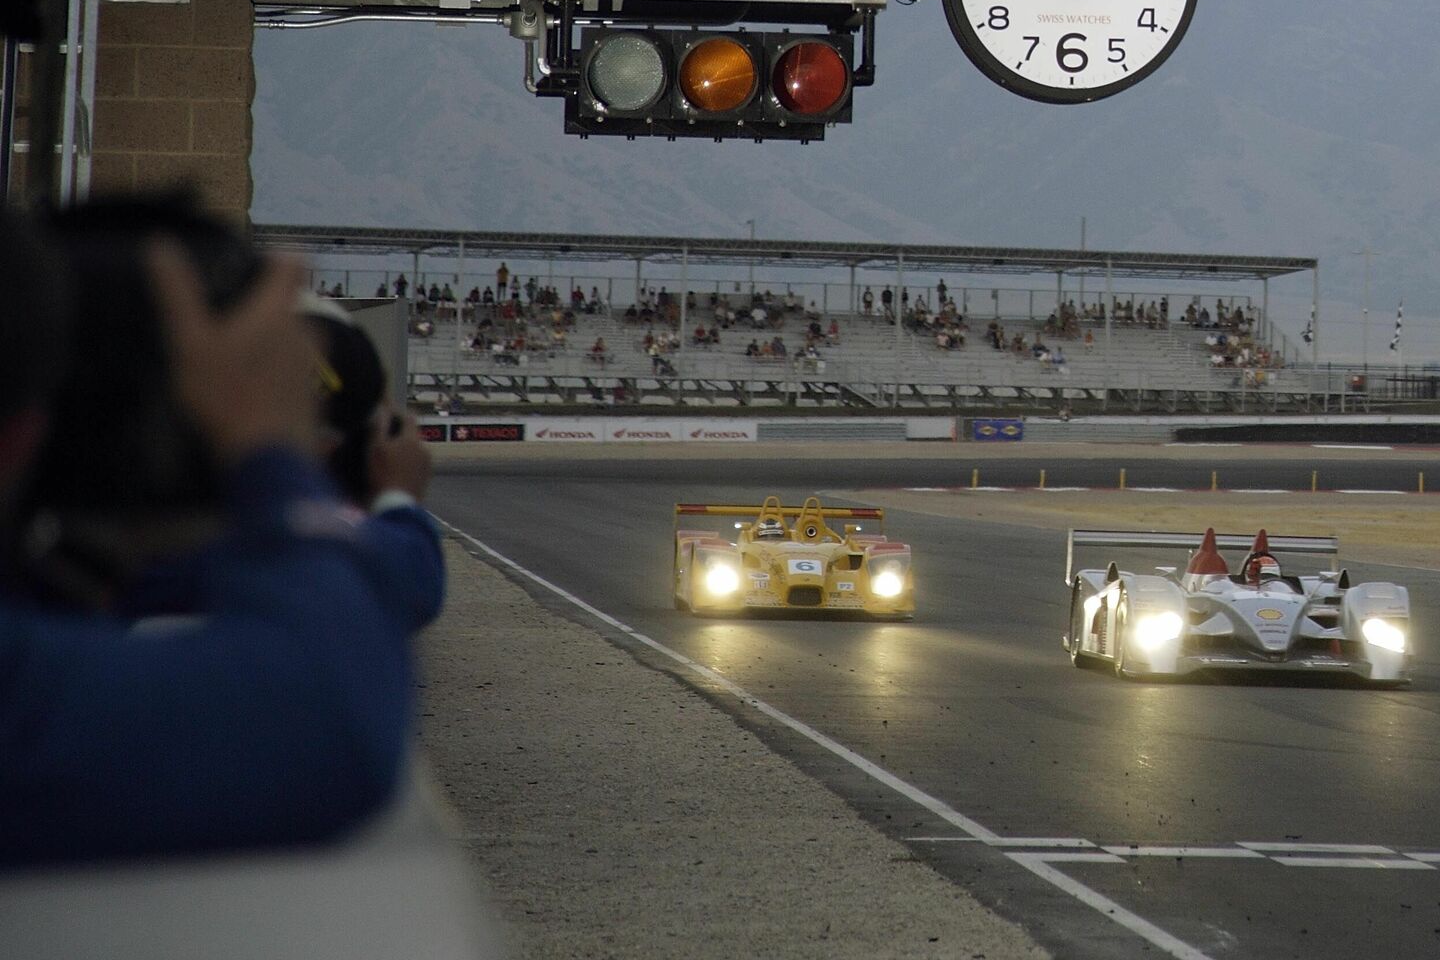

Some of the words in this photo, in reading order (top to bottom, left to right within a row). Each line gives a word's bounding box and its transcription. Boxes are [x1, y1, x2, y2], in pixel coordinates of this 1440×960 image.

[988, 5, 1010, 31] 8
[1036, 13, 1064, 24] SWISS
[1066, 14, 1112, 24] WATCHES
[1137, 8, 1158, 33] 4
[1022, 36, 1040, 61] 7
[1056, 33, 1089, 73] 6
[1107, 38, 1126, 63] 5
[549, 431, 596, 439] HONDA
[627, 431, 671, 439] HONDA
[704, 431, 748, 439] HONDA
[795, 561, 815, 571] 6
